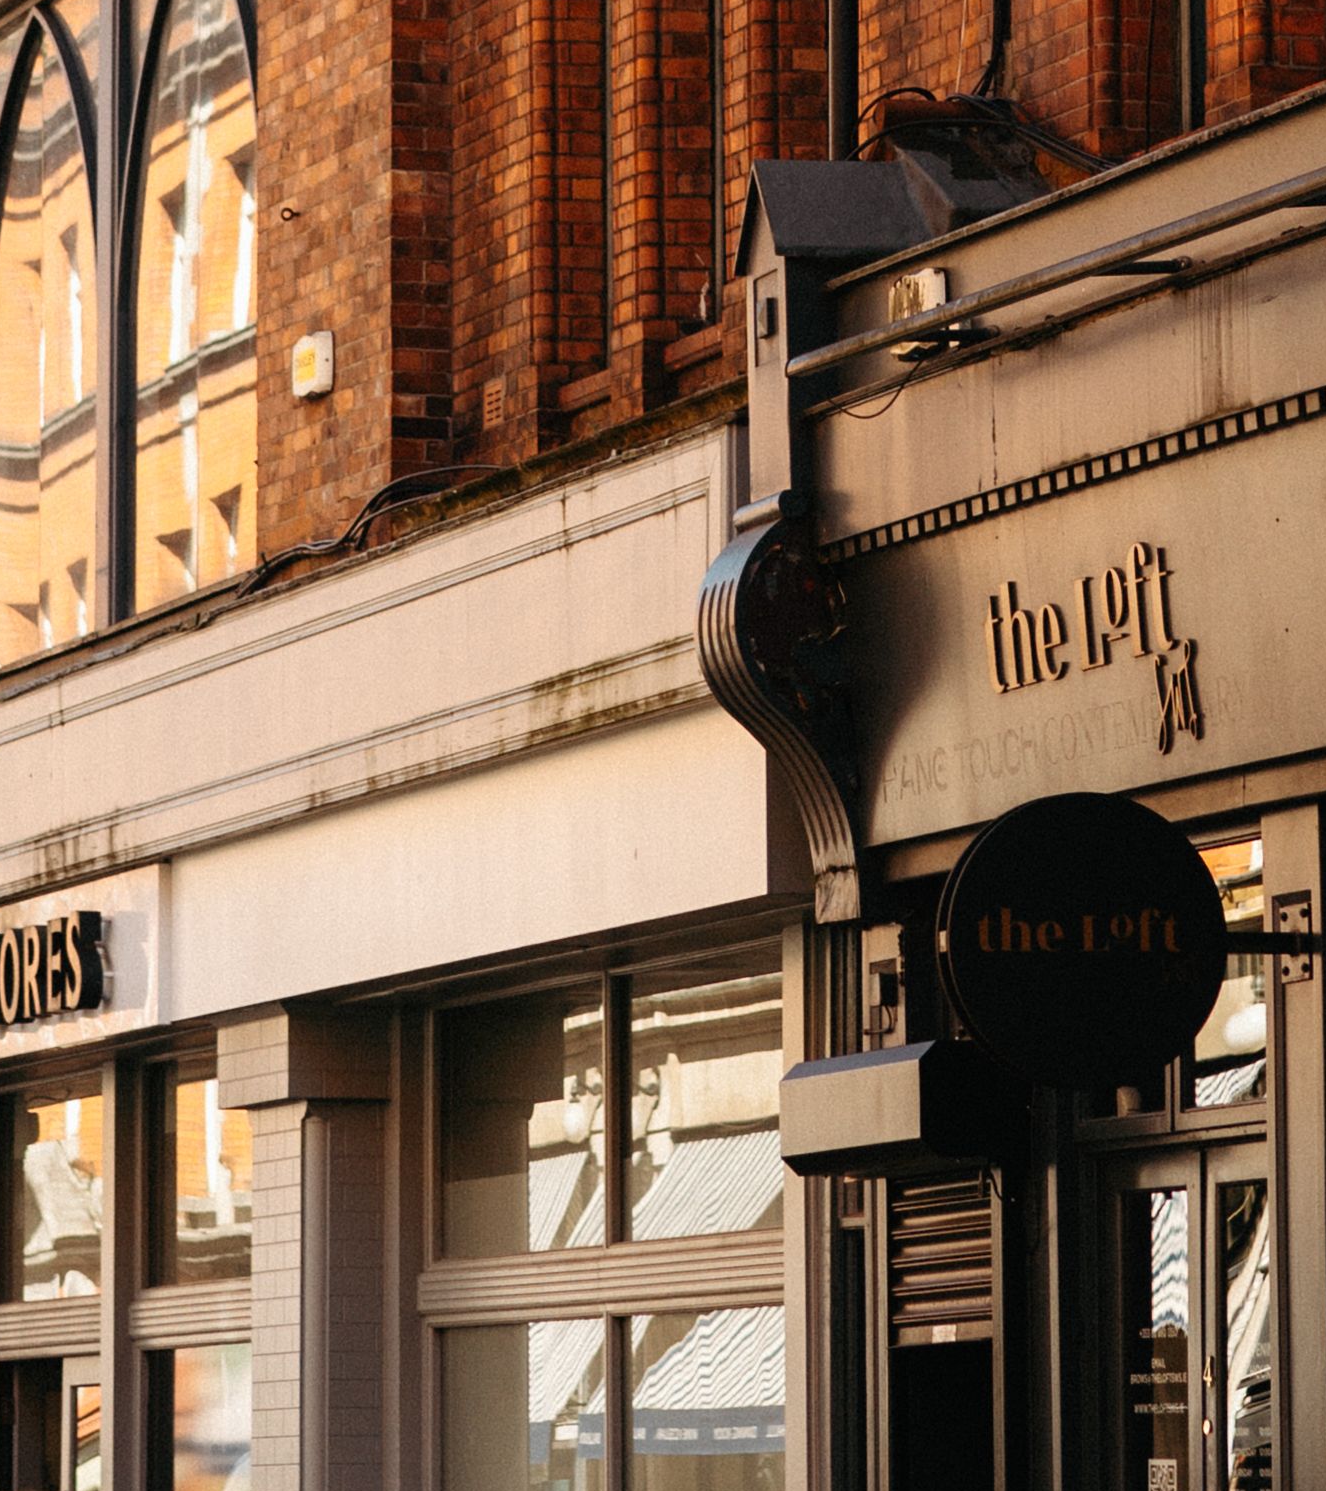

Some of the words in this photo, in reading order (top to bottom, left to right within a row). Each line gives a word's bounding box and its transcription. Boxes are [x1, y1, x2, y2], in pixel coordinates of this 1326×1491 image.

[984, 581, 1069, 694] the
[978, 906, 1064, 953] the
[1203, 1356, 1212, 1387] 4
